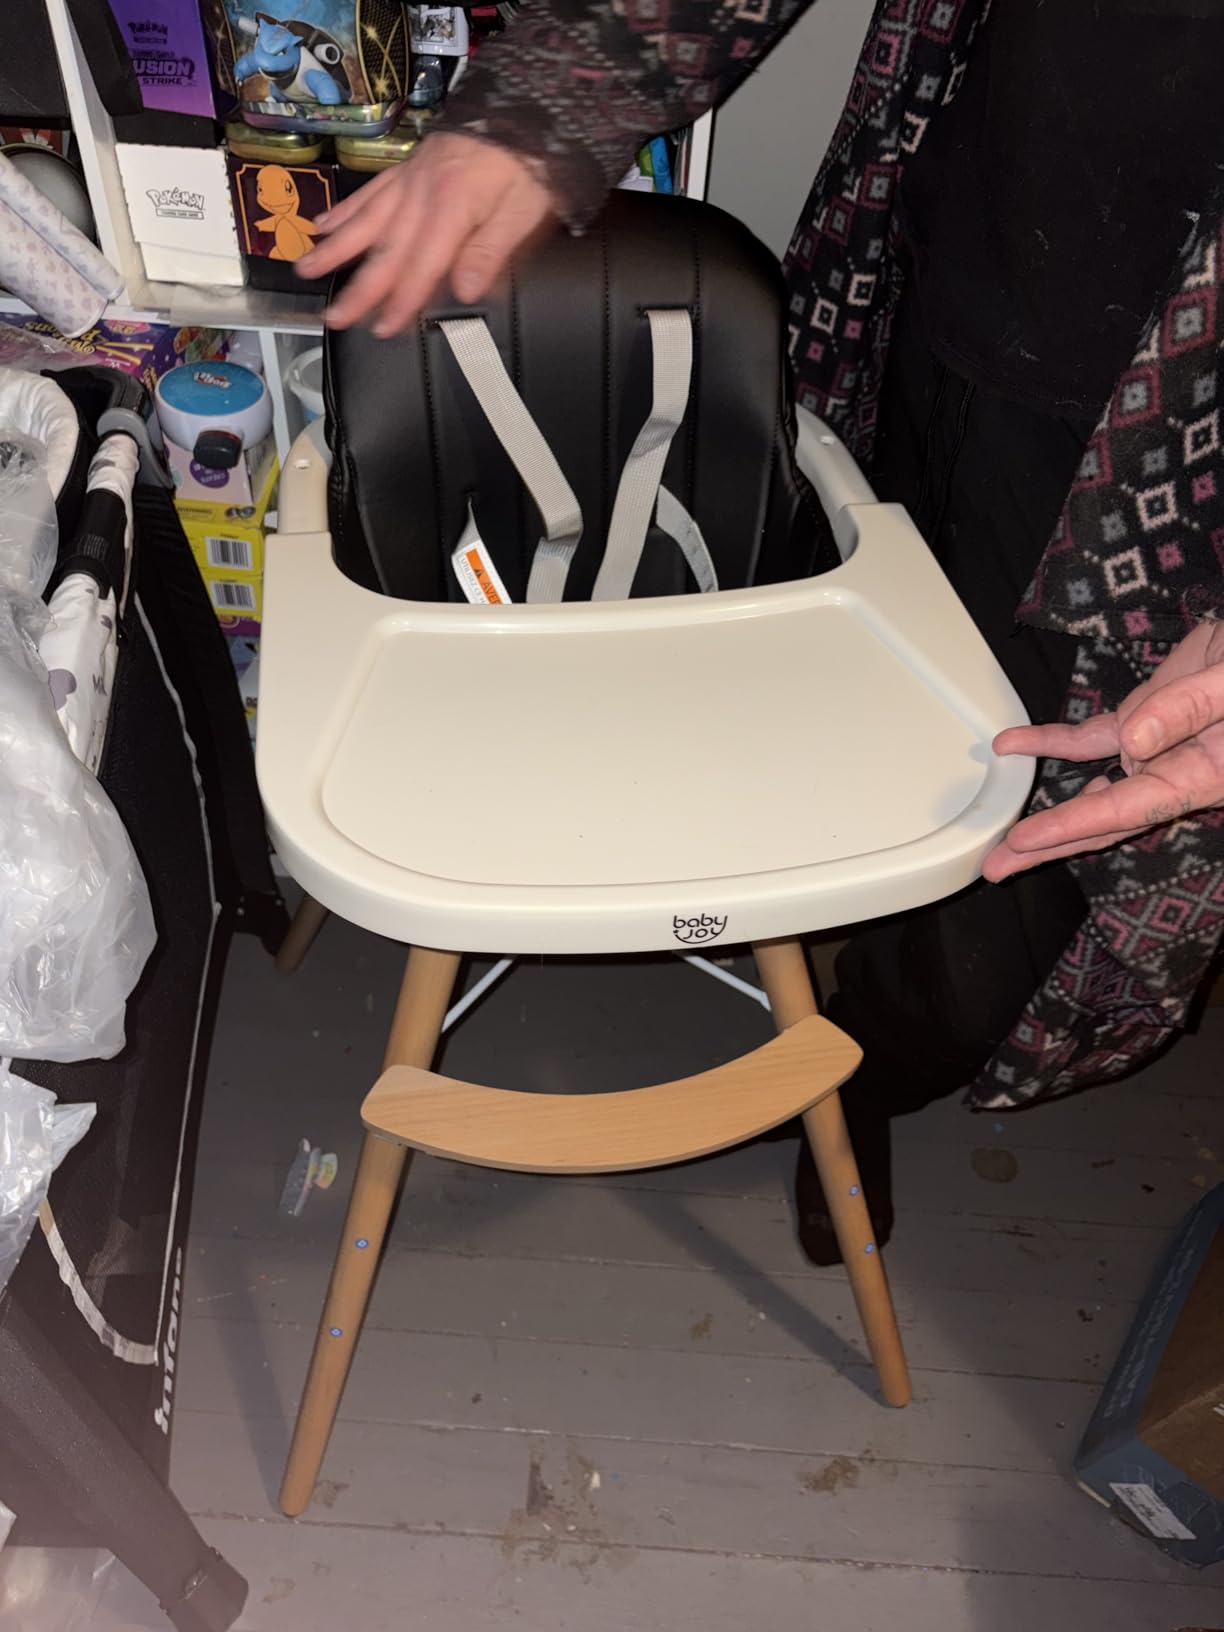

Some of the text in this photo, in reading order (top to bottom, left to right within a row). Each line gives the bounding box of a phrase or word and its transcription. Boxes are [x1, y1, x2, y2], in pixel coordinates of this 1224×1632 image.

[132, 58, 194, 78] USION
[142, 77, 183, 87] STRIKE
[673, 913, 728, 930] baby
[682, 926, 724, 941] joy
